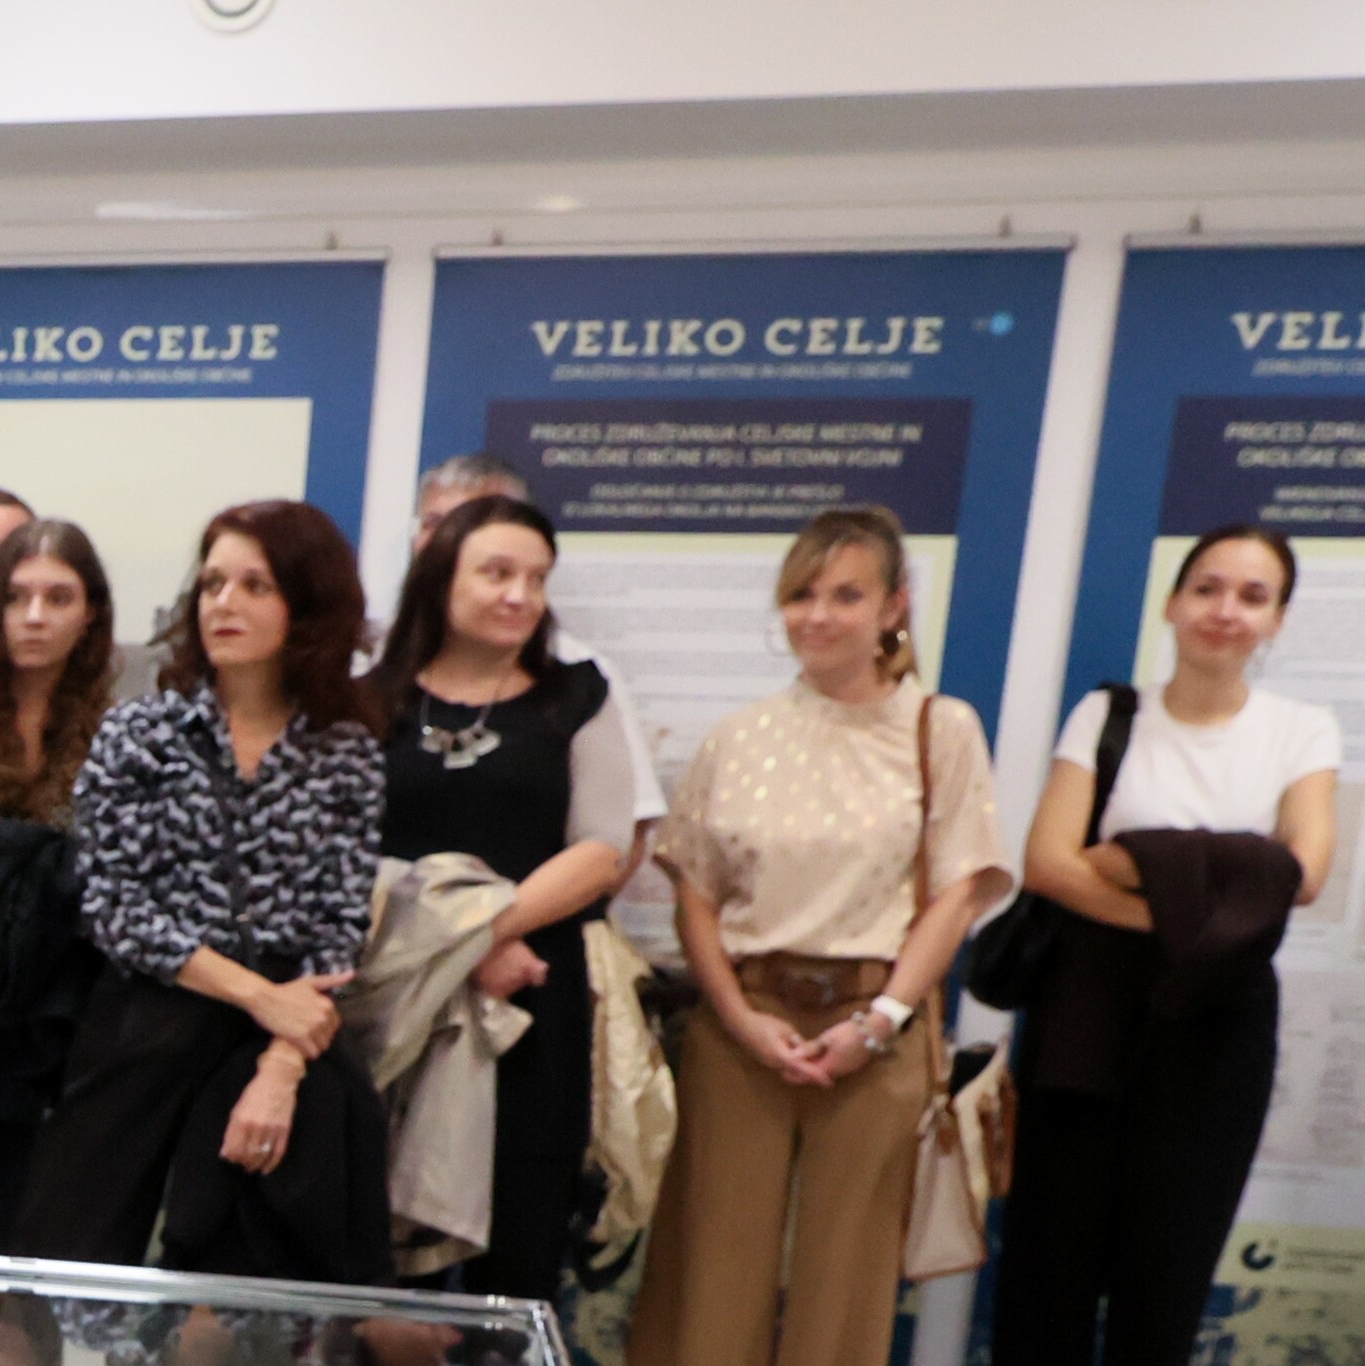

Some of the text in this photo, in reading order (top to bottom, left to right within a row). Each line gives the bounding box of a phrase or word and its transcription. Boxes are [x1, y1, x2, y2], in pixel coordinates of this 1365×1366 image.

[120, 324, 280, 361] CELJE
[531, 316, 945, 357] VELIKO CELJE
